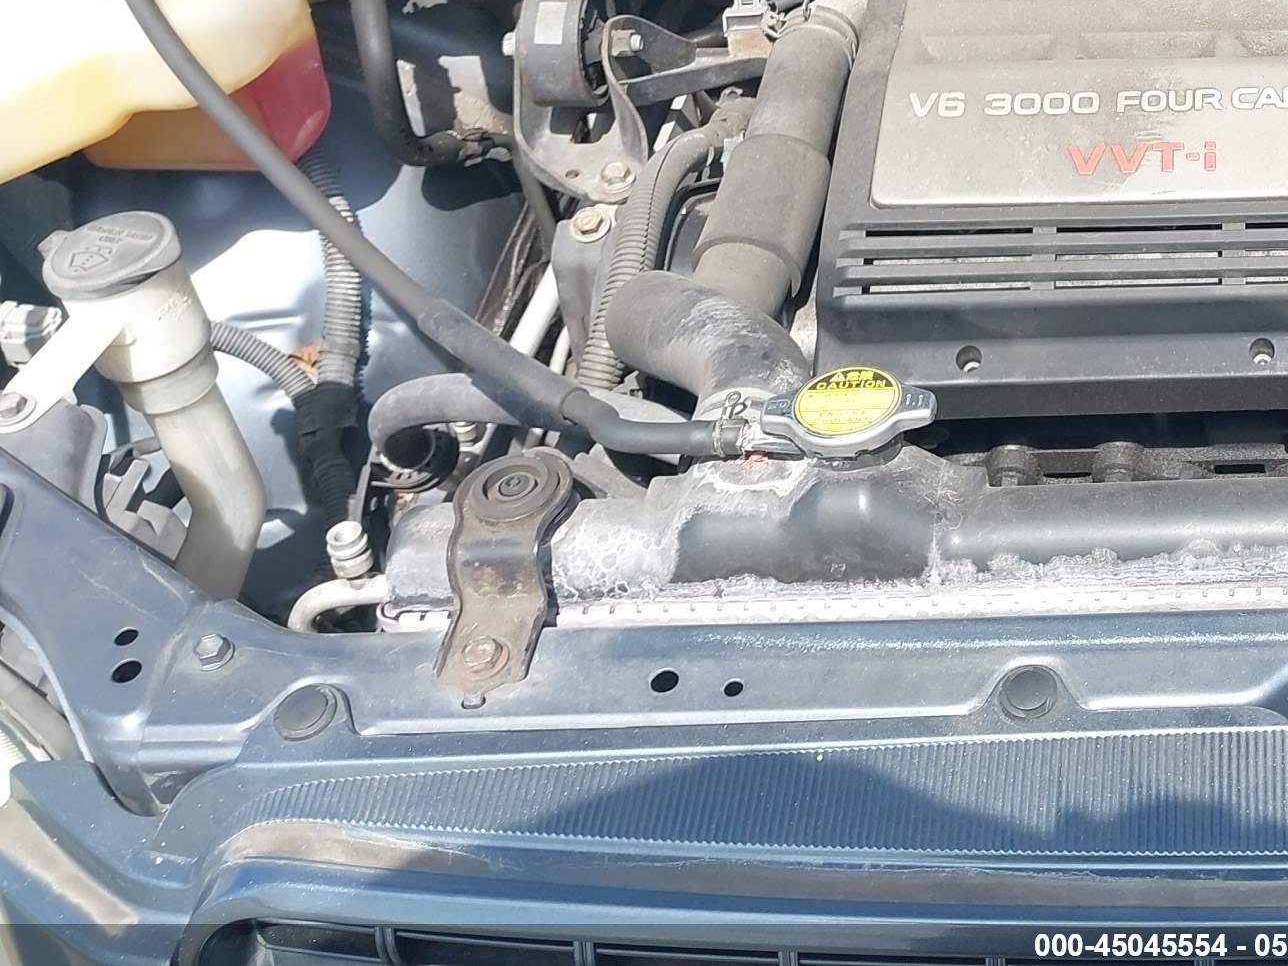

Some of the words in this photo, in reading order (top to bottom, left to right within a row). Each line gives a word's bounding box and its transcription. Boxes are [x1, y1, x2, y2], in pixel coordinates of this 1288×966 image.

[909, 91, 966, 118] V6
[983, 91, 1100, 116] 3000
[1116, 87, 1224, 113] FOUR
[1067, 140, 1217, 176] VVT-i
[816, 379, 887, 390] CAUTION
[905, 394, 924, 406] 1.1
